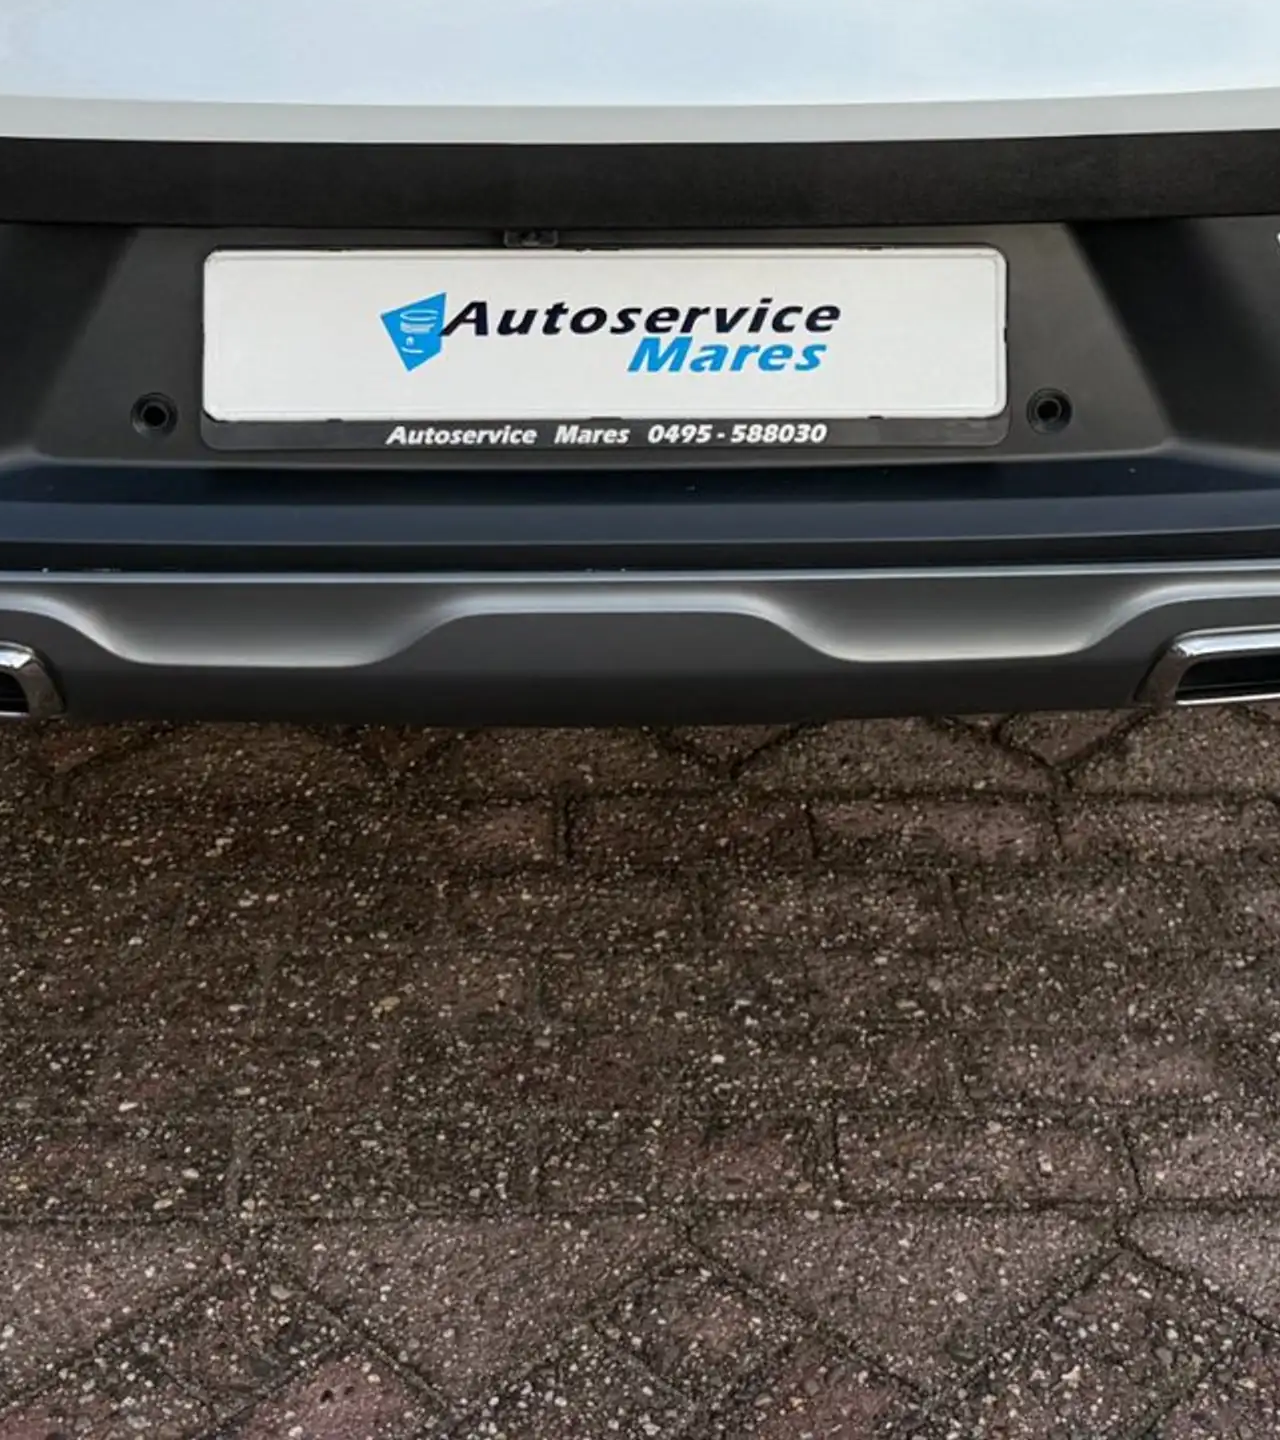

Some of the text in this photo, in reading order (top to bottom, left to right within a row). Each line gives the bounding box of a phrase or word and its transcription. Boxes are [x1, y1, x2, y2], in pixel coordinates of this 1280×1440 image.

[440, 297, 841, 337] Autoservice
[627, 336, 827, 373] Mares
[385, 424, 538, 445] Autoservice
[553, 424, 631, 445] Mares
